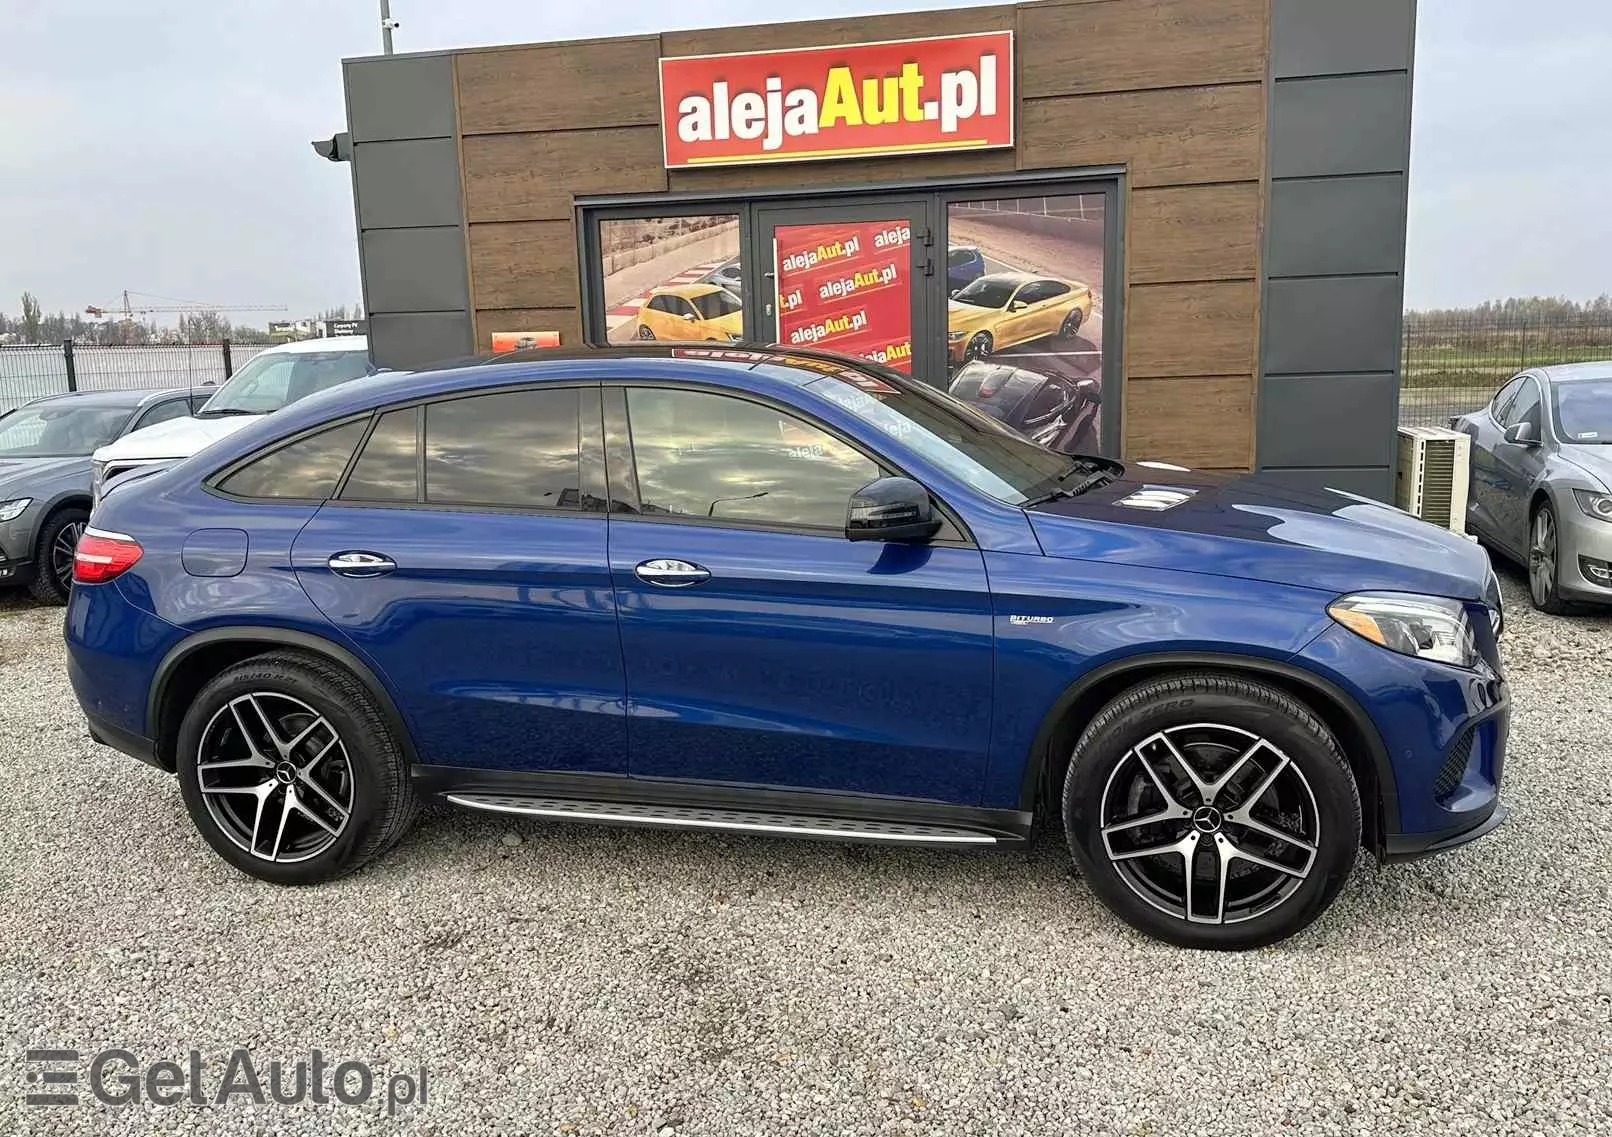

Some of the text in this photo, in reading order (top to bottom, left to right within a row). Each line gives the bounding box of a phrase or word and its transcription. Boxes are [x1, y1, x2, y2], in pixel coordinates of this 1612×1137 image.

[677, 54, 997, 151] alejaAut.pl
[782, 236, 860, 271] alejaAut.pl
[818, 263, 897, 298] alejaAut.pl
[790, 310, 867, 344] alejaAut.pl
[1009, 614, 1055, 624] BITURBO
